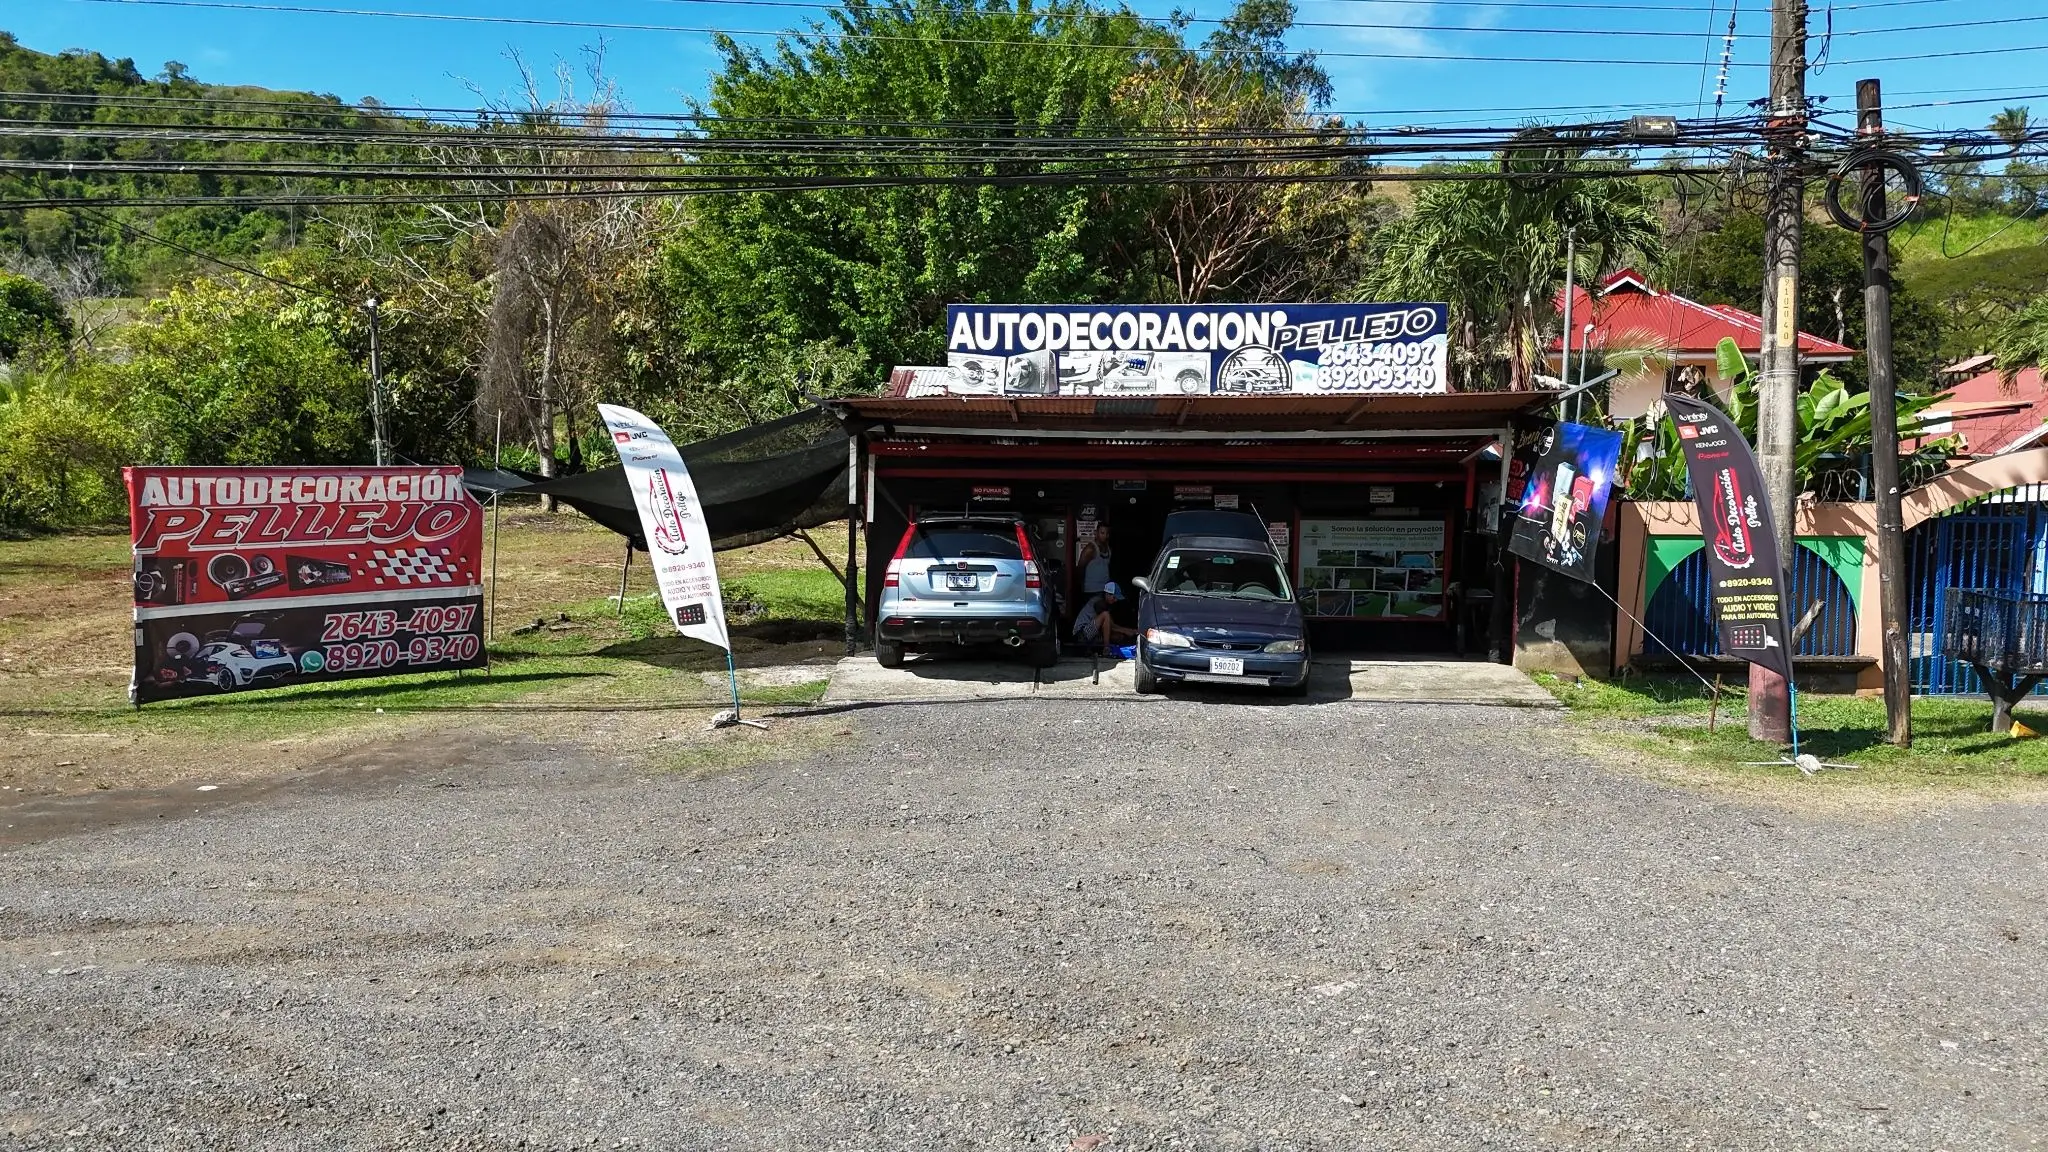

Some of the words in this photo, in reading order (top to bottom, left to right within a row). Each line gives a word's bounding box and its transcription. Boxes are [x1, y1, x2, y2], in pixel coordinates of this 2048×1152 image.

[950, 312, 1271, 350] AUTODECORACION
[1272, 307, 1436, 353] PELLEJO
[1318, 342, 1436, 366] 2643-4097
[1317, 366, 1436, 390] 8920-9340
[632, 431, 648, 440] JVC
[1700, 425, 1718, 436] JVC
[1695, 440, 1727, 448] KENWOOD
[139, 469, 464, 507] AUTODECORACIÓN
[1719, 468, 1740, 526] Decoración
[1744, 494, 1762, 528] Pellejo
[134, 502, 471, 554] PELLEJO
[1732, 526, 1746, 552] Auto
[1727, 578, 1773, 588] 8920-9340
[1716, 596, 1734, 604] TODO
[1743, 594, 1778, 602] ACCESORIOS
[1722, 604, 1746, 612] AUDIO
[1752, 602, 1776, 611] VIDEO
[320, 604, 477, 642] 2643-4097
[1746, 612, 1779, 620] AUTOMOVIL
[324, 634, 480, 673] 8920-9340
